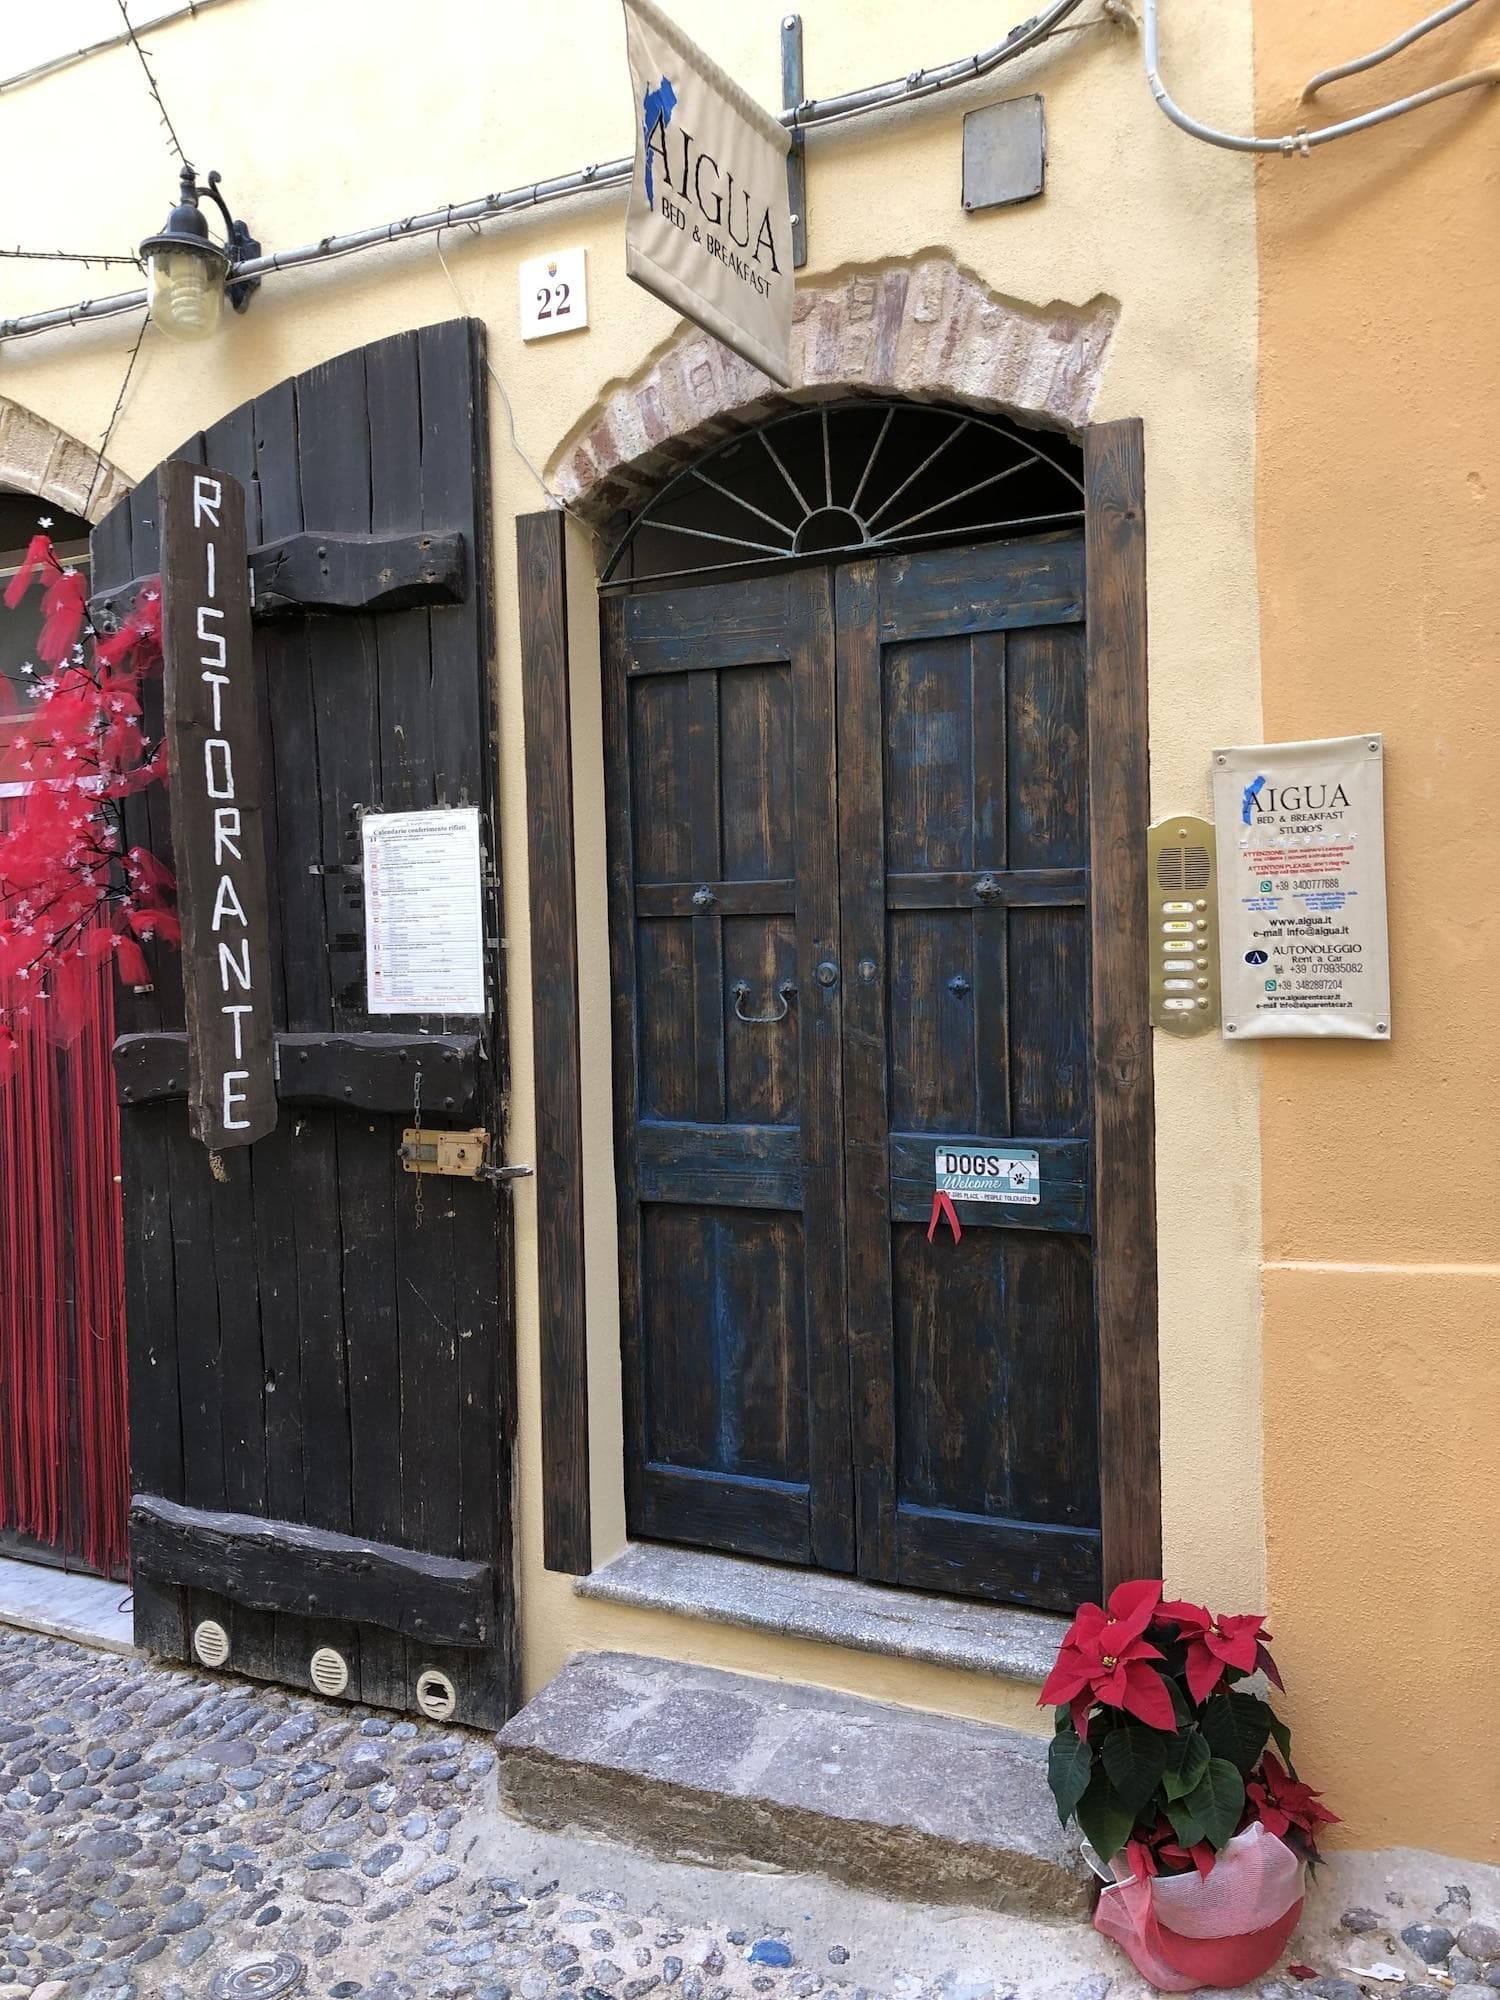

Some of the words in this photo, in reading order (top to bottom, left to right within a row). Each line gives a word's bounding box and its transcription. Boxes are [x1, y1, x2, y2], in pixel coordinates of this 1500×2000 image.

[647, 107, 782, 275] AIGUA
[661, 196, 686, 231] BED
[692, 224, 702, 244] &
[706, 233, 772, 298] BREAKFAST
[536, 283, 571, 320] 22
[194, 474, 253, 1129] RISTORANTE
[1244, 783, 1352, 813] AIGUA
[1257, 816, 1275, 824] BED
[1279, 815, 1286, 823] &
[1291, 811, 1344, 822] BREAKFAST
[1280, 824, 1323, 834] STUDIO'S
[1275, 880, 1289, 891] +39
[1269, 916, 1332, 927] www.aigua.it
[1253, 928, 1282, 938] e-mail
[1286, 926, 1349, 937] info@aigua.it
[1272, 944, 1362, 955] AUTONOLEGGIO
[1292, 955, 1312, 963] Rent
[1327, 954, 1342, 963] Car
[1290, 964, 1306, 974] +39
[1278, 980, 1292, 990] +39
[945, 1153, 1000, 1176] DOGS
[942, 1175, 1002, 1189] Welcome
